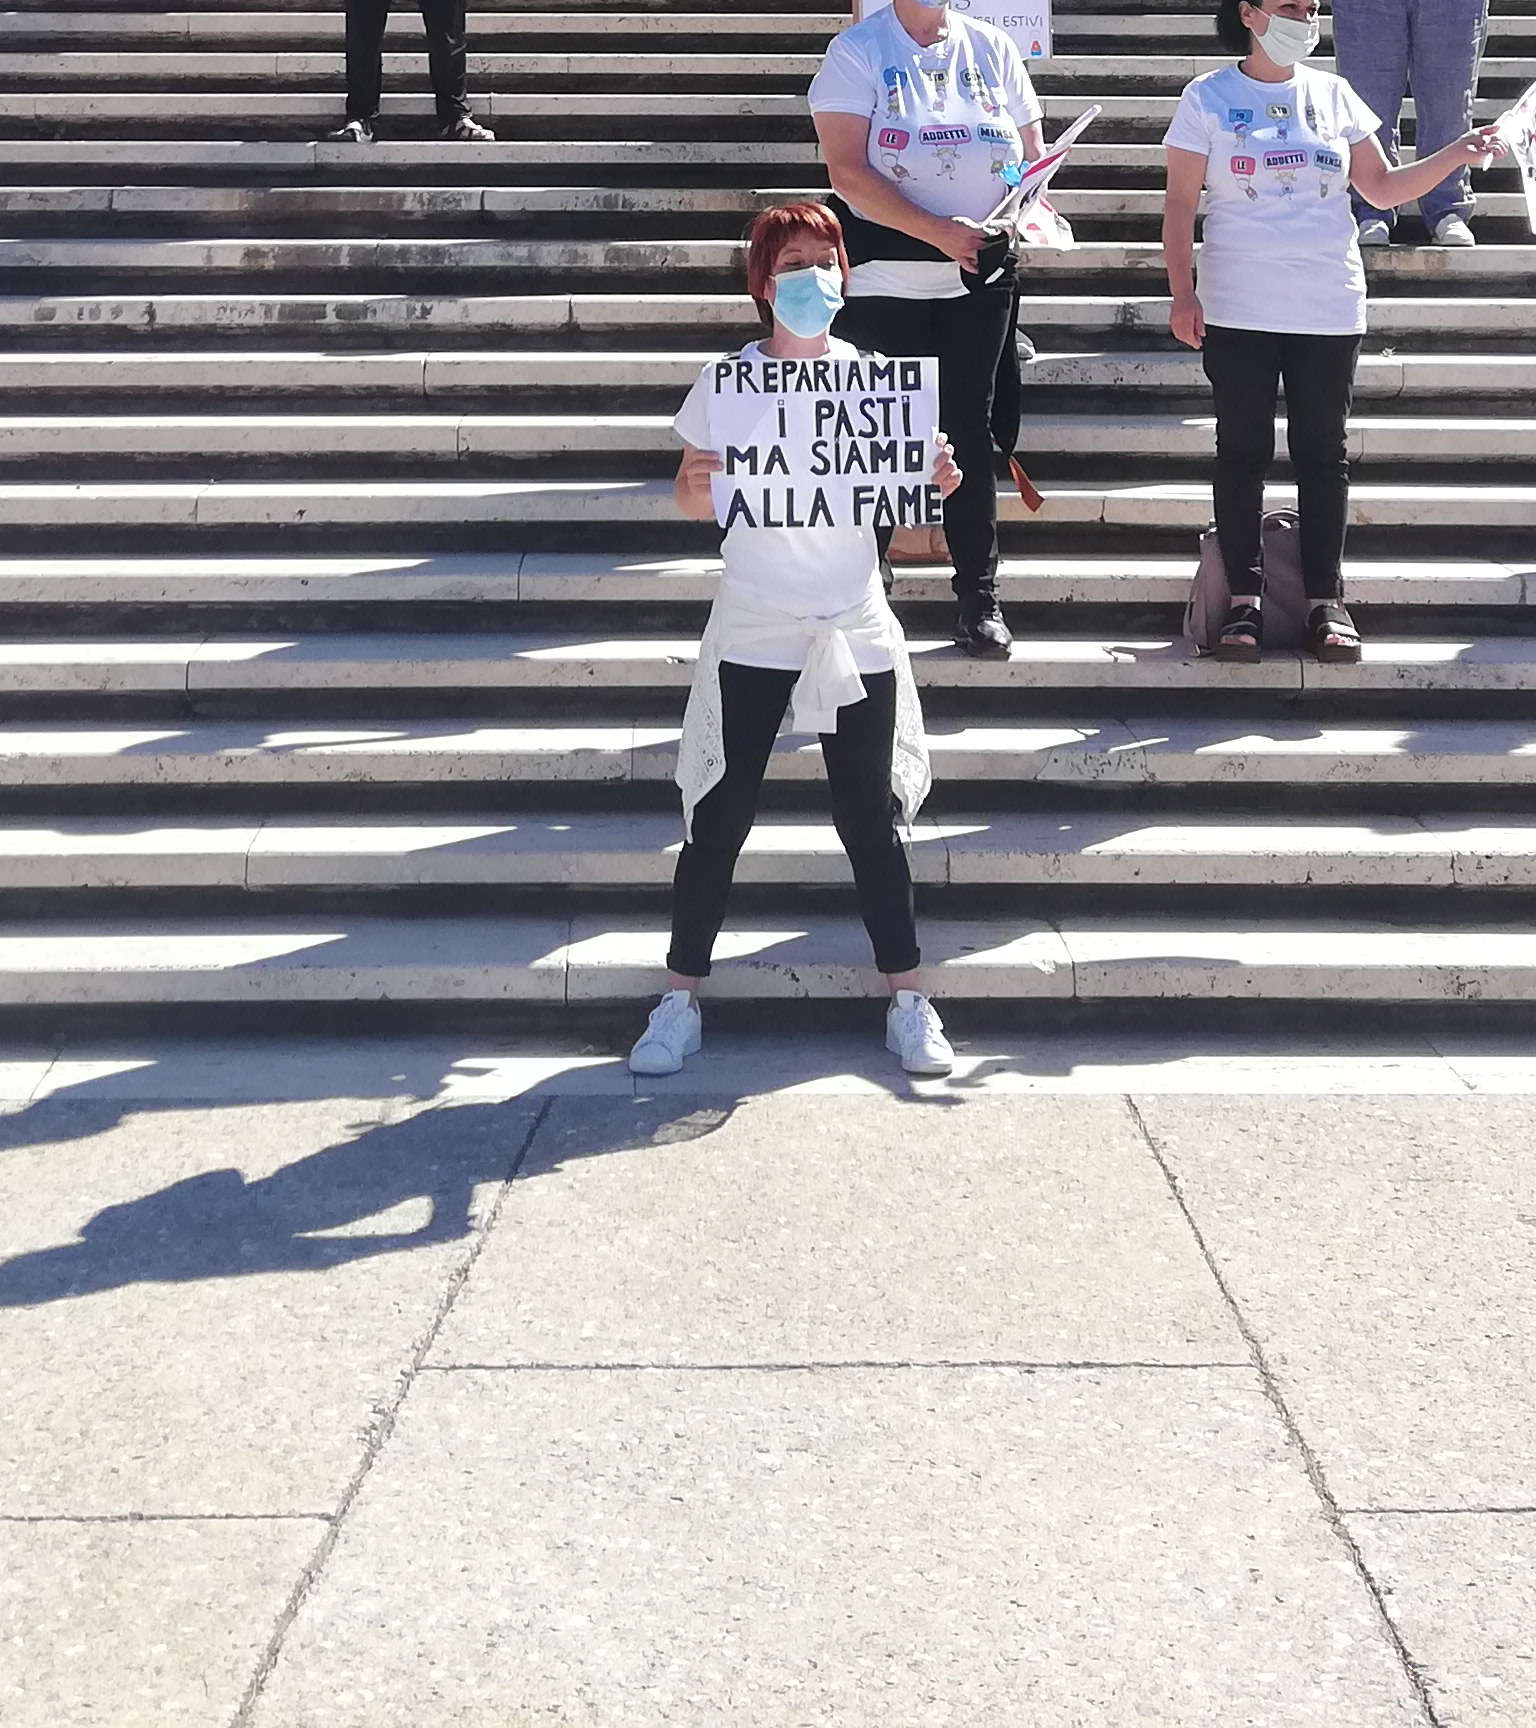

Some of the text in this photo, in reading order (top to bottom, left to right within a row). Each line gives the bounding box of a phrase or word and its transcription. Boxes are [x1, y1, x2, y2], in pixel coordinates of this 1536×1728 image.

[1002, 15, 1045, 28] ESTIVI
[885, 132, 898, 144] LE
[922, 128, 968, 142] ADDETTE
[1237, 160, 1246, 170] LE
[1266, 153, 1305, 167] ADDETTE
[714, 360, 922, 395] PREPARIAMO
[815, 395, 912, 439] PASTI
[726, 437, 925, 476] MA SIAMO
[726, 483, 942, 528] ALLA FAME
